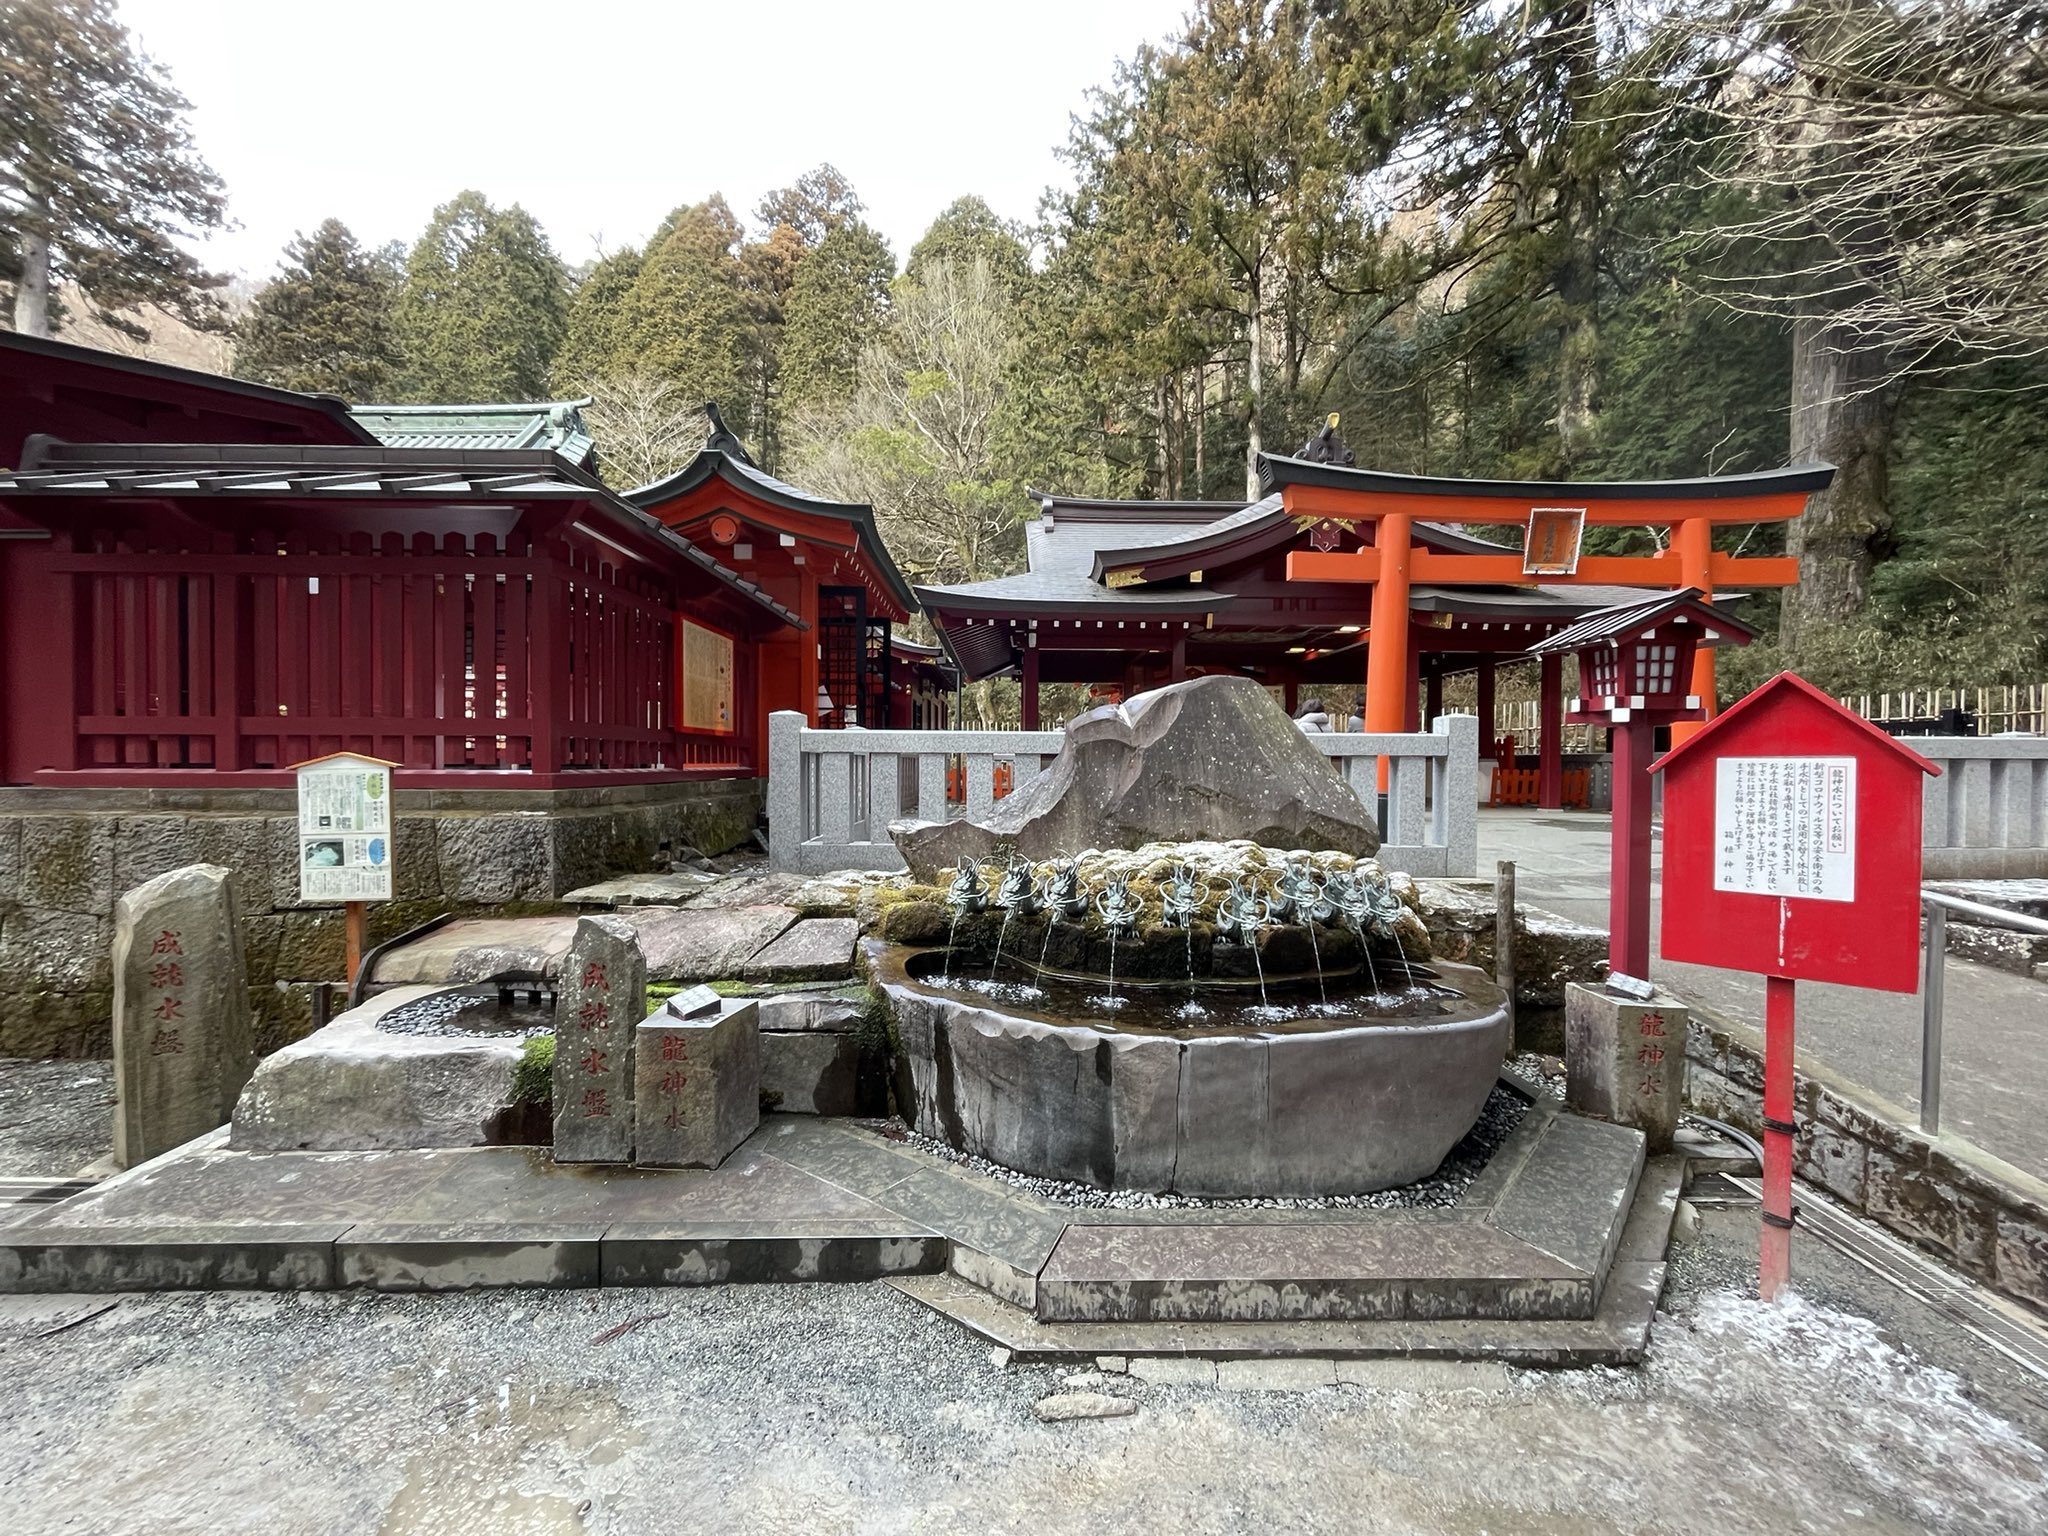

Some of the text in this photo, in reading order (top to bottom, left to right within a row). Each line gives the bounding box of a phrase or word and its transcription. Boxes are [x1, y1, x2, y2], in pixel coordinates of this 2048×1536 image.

[150, 930, 185, 1056] 成就水盤
[579, 962, 612, 1118] 成就水盤
[661, 1035, 689, 1130] 龍神水
[1636, 1010, 1666, 1096] 龍神水
